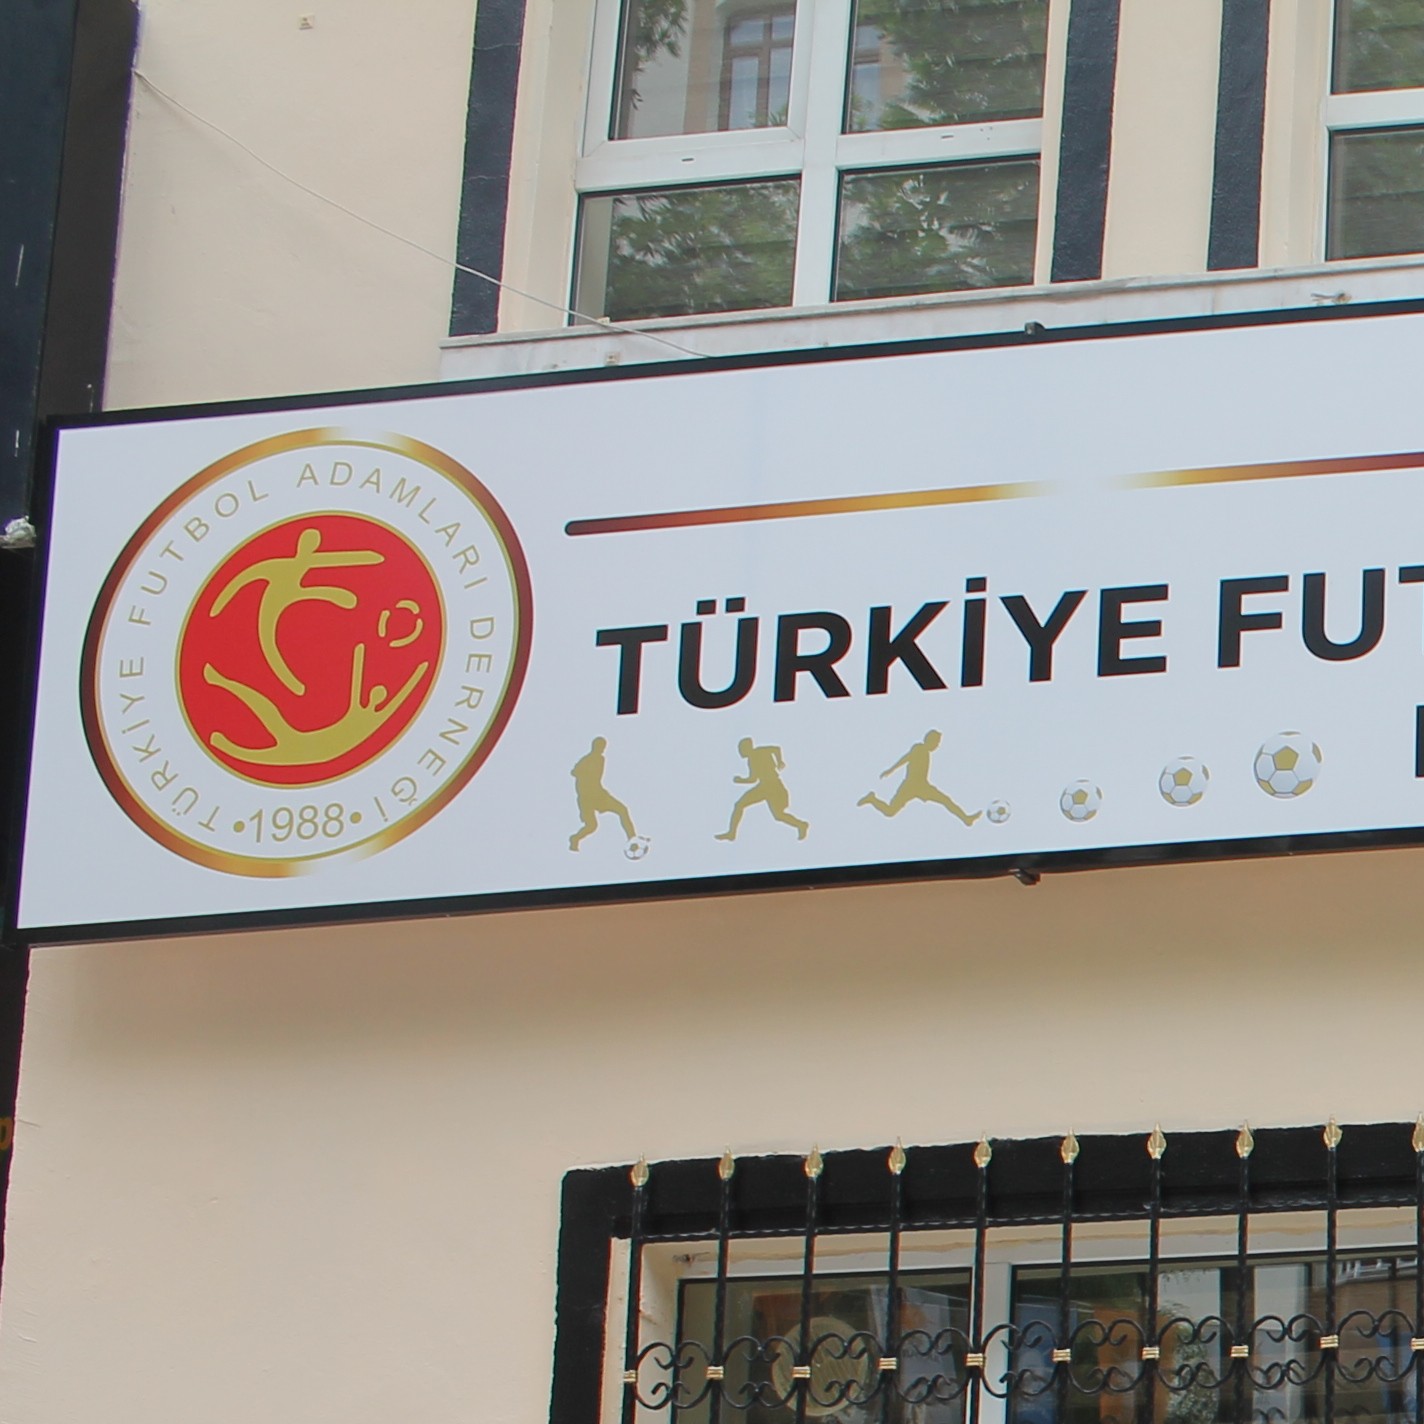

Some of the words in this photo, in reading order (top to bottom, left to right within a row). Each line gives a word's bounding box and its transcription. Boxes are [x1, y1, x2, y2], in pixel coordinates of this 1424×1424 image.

[128, 479, 269, 627] FUTBOL
[296, 461, 488, 591] ADAMLARI
[595, 576, 1169, 716] TÜRKİYE
[119, 655, 220, 833] TÜRKİYE
[376, 616, 495, 823] DERNEĞİ
[247, 802, 346, 844] 1988
